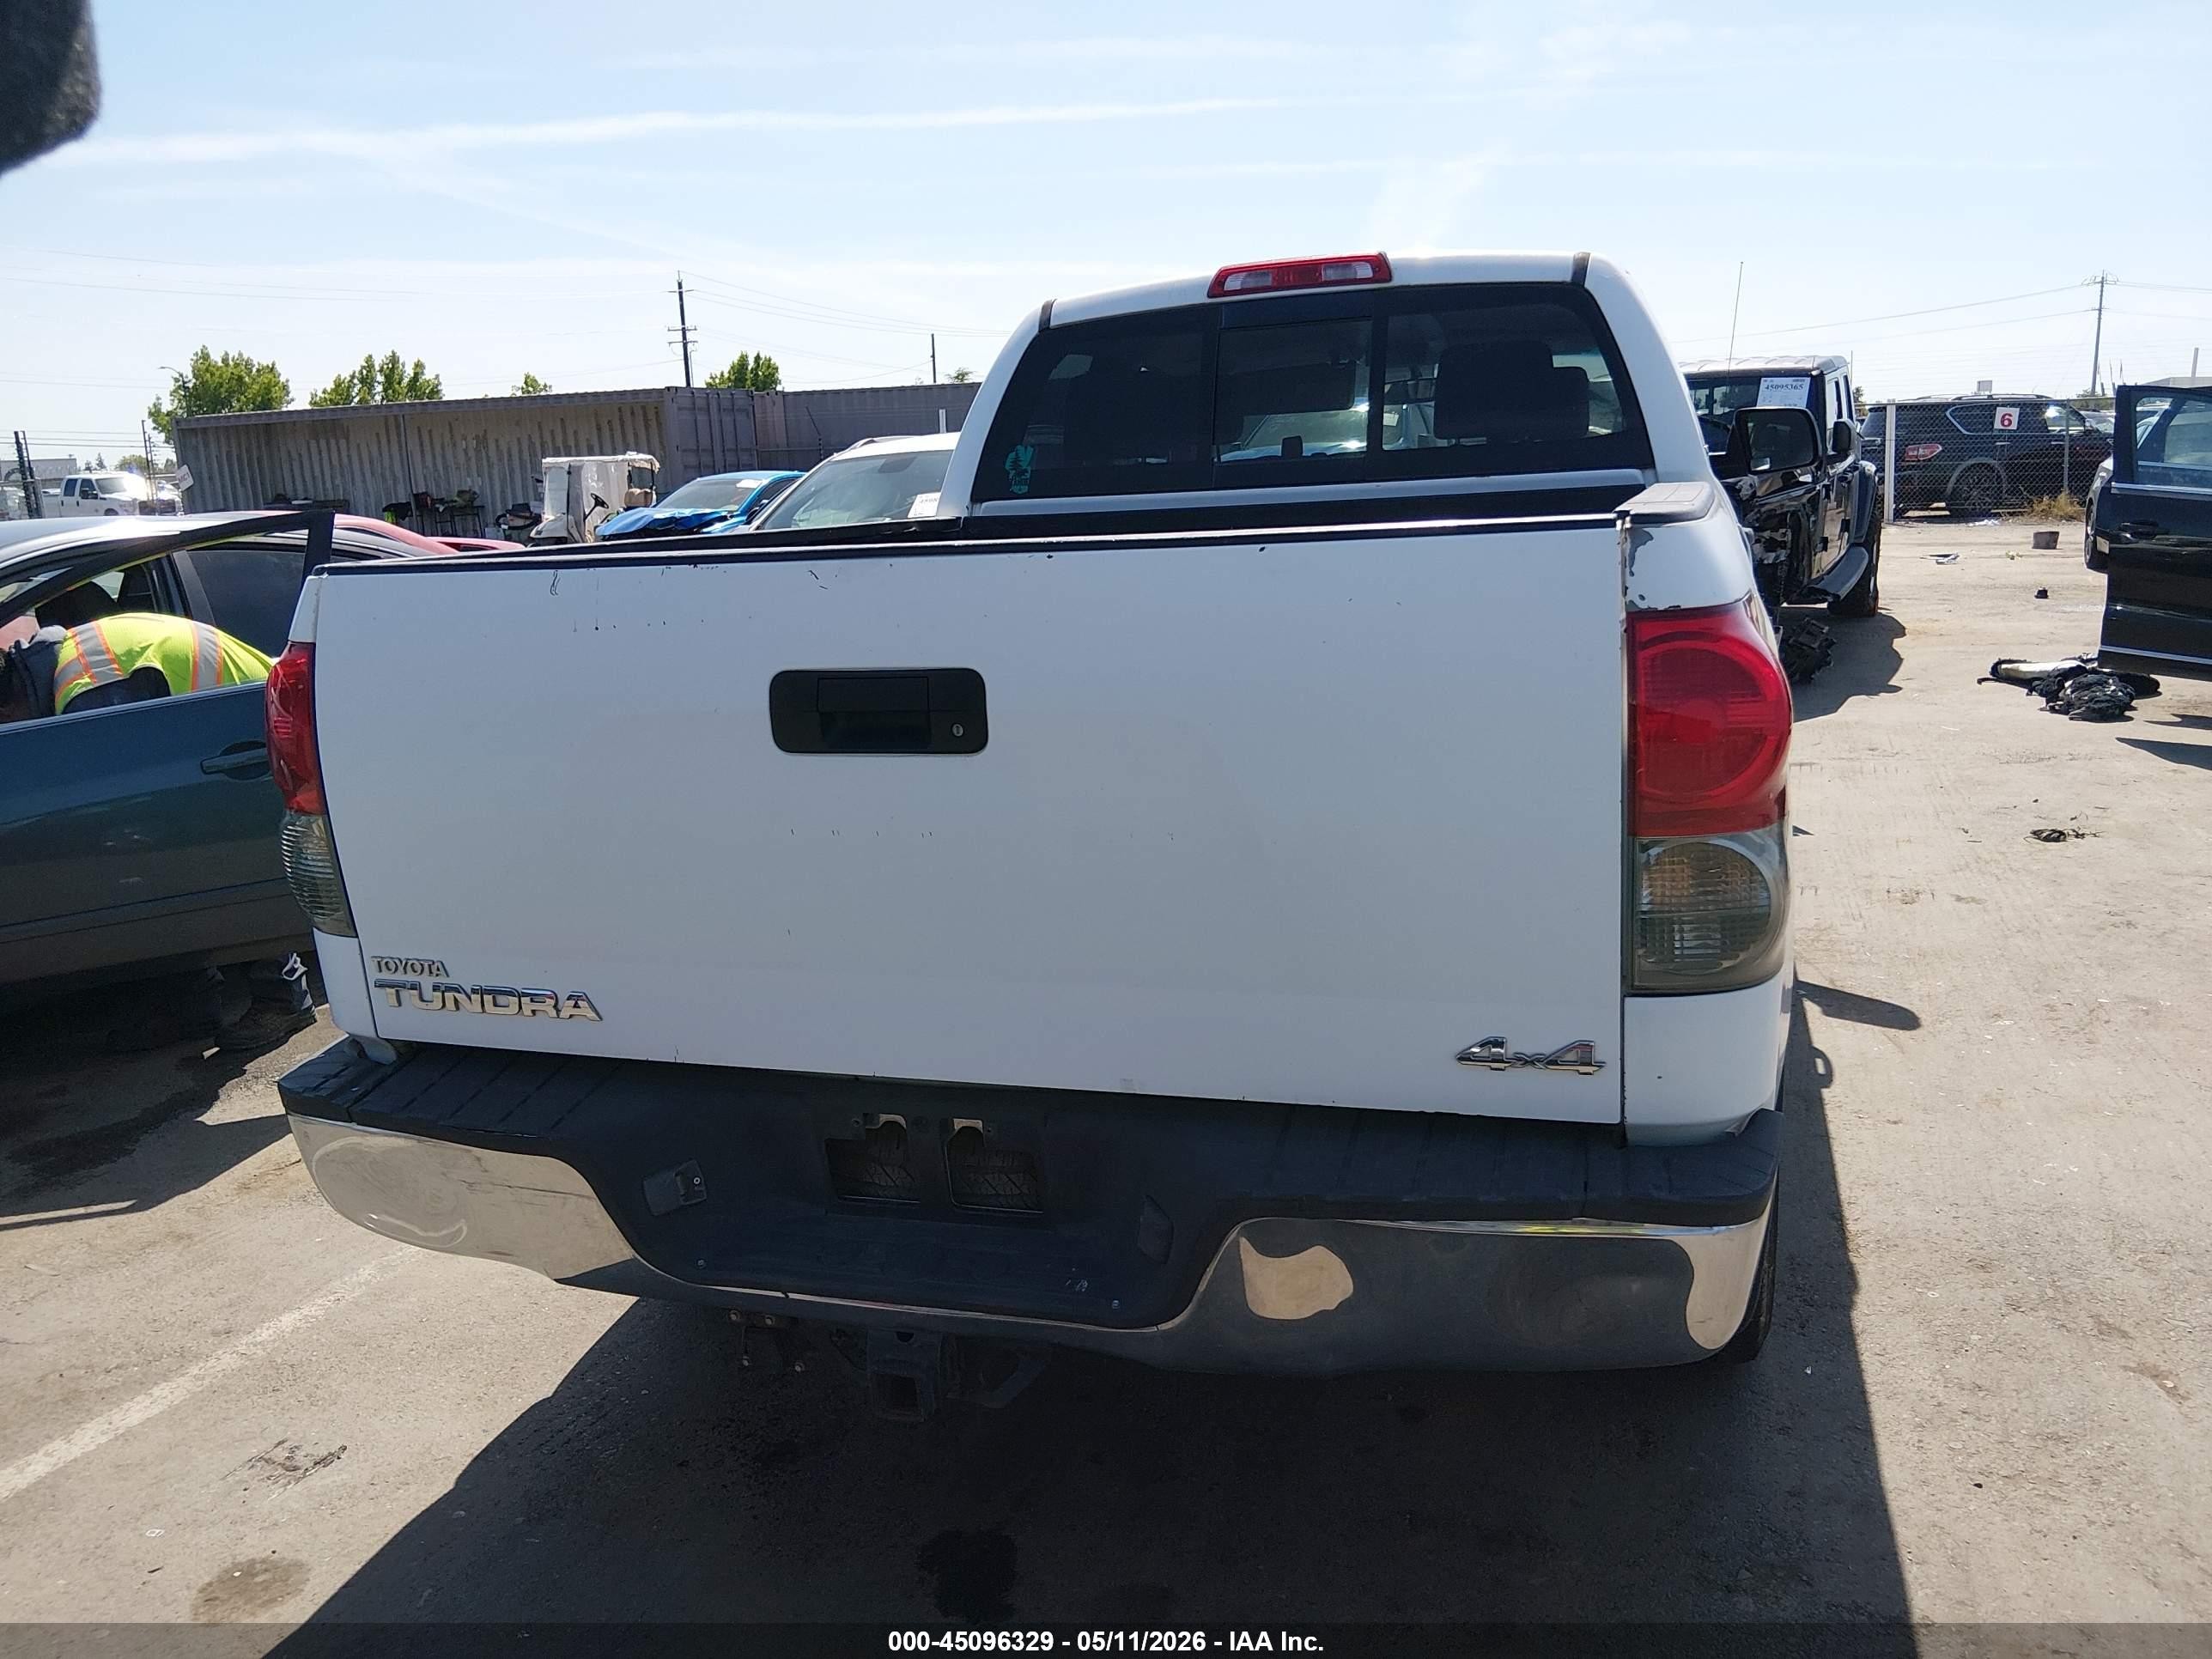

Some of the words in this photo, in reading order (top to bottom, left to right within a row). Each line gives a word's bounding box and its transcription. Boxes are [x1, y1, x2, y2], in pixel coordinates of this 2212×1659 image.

[2000, 413, 2013, 428] 6
[371, 956, 450, 977] TOYOTA
[374, 979, 604, 1022] TUNDRA
[1455, 1036, 1607, 1076] 4x4
